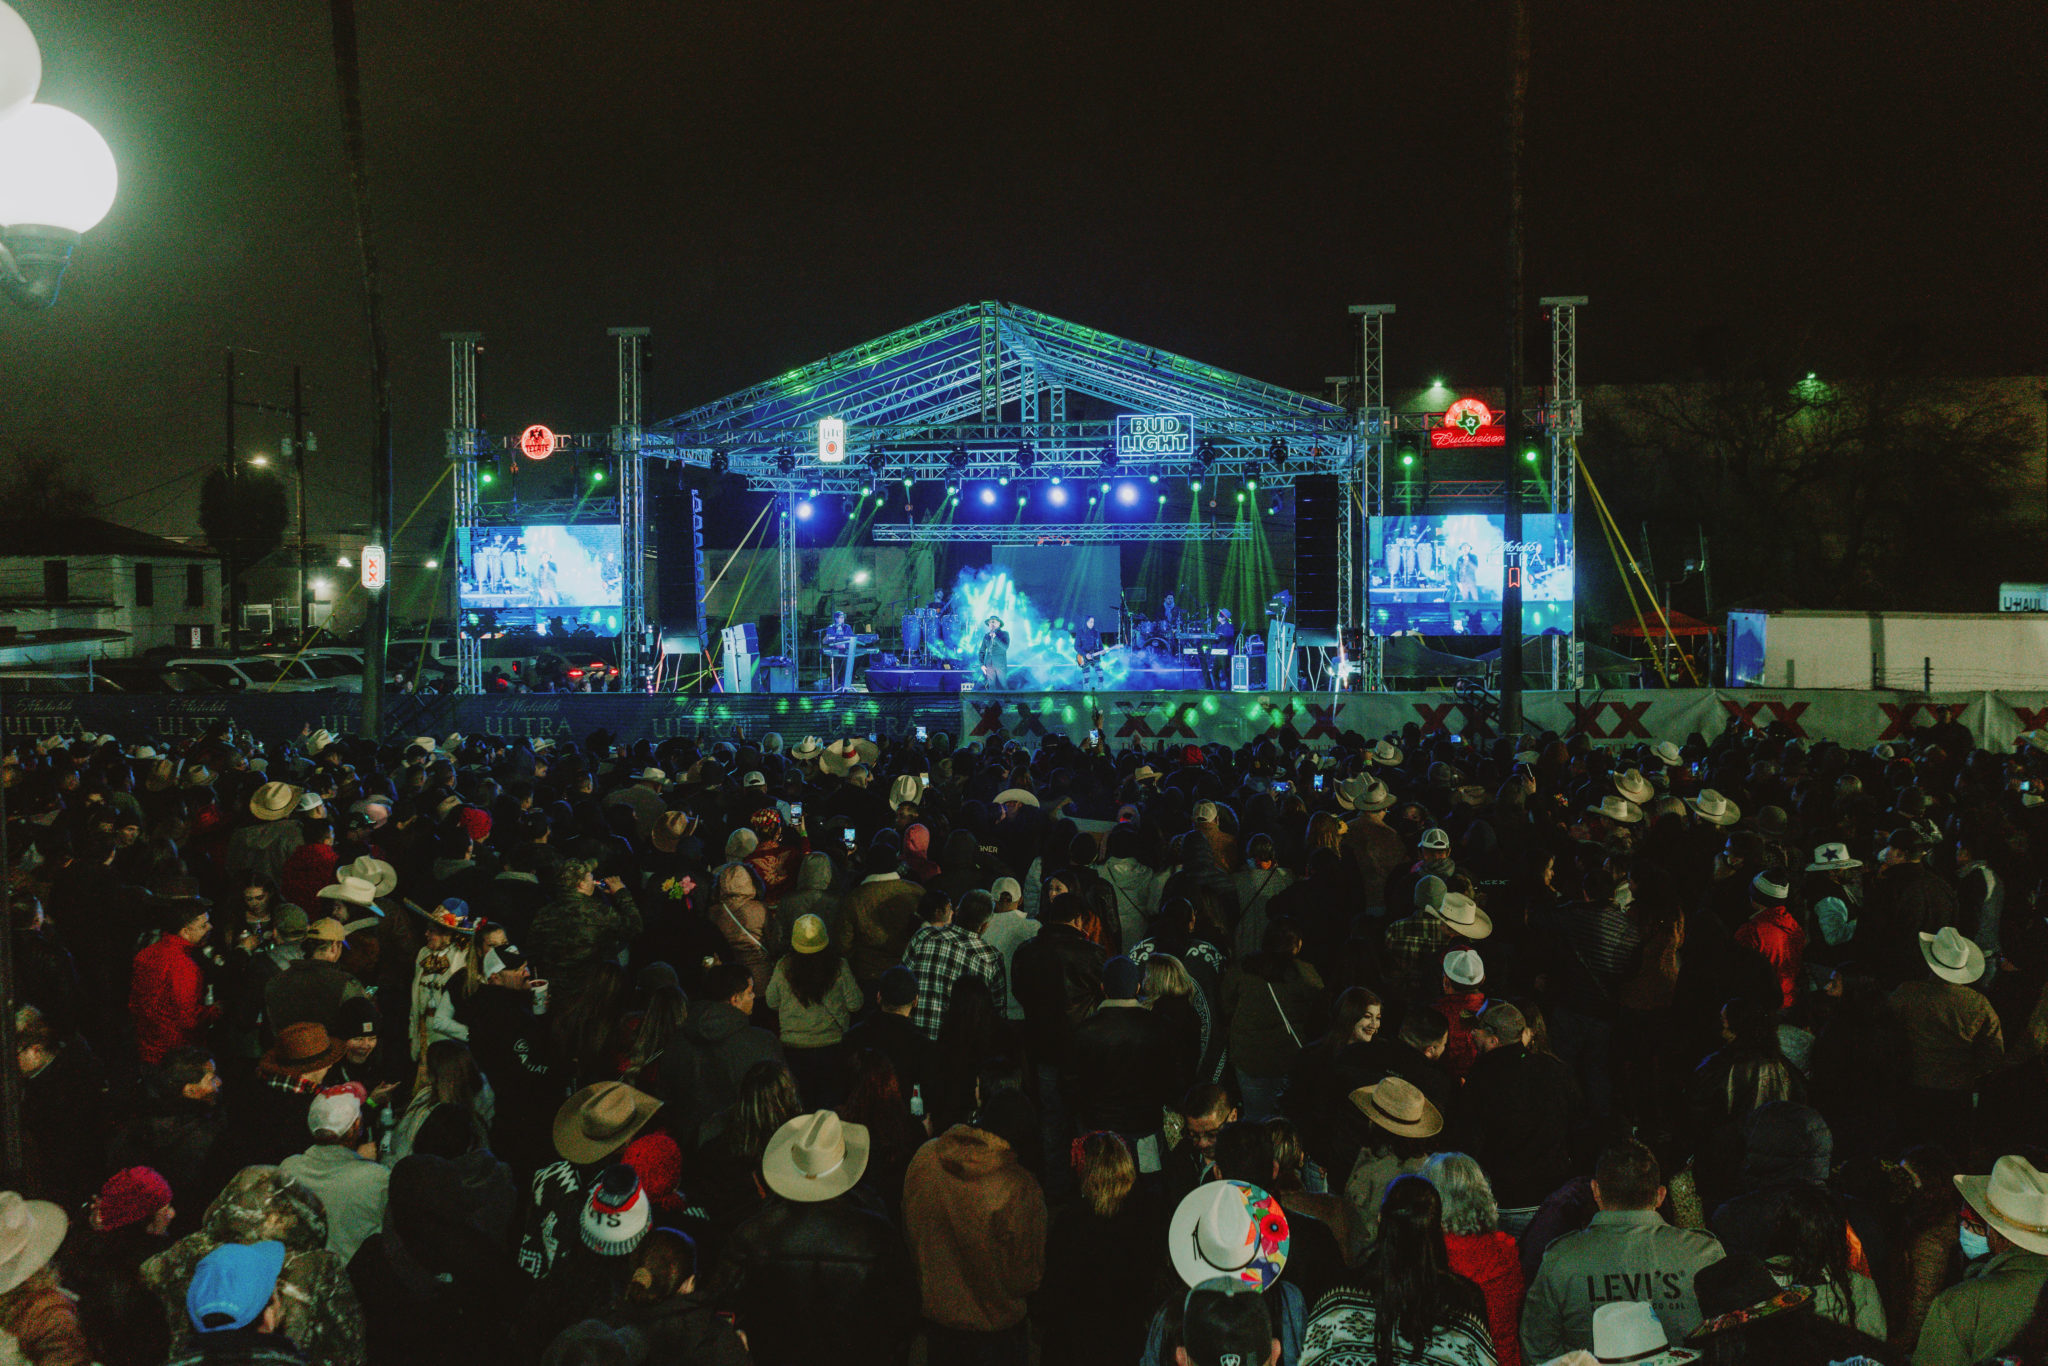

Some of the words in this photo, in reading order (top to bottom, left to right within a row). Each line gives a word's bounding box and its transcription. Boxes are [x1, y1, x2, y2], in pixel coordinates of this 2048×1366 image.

[1446, 399, 1492, 424] TEXAS
[1130, 416, 1180, 435] BUD
[1121, 434, 1189, 453] LIGHT
[1432, 432, 1505, 446] Budweiser
[5, 716, 85, 736] ULTRA
[484, 716, 571, 737] ULTRA
[1114, 701, 1199, 739] XX
[1561, 701, 1651, 738] XX
[1586, 1271, 1682, 1303] LEVI'S
